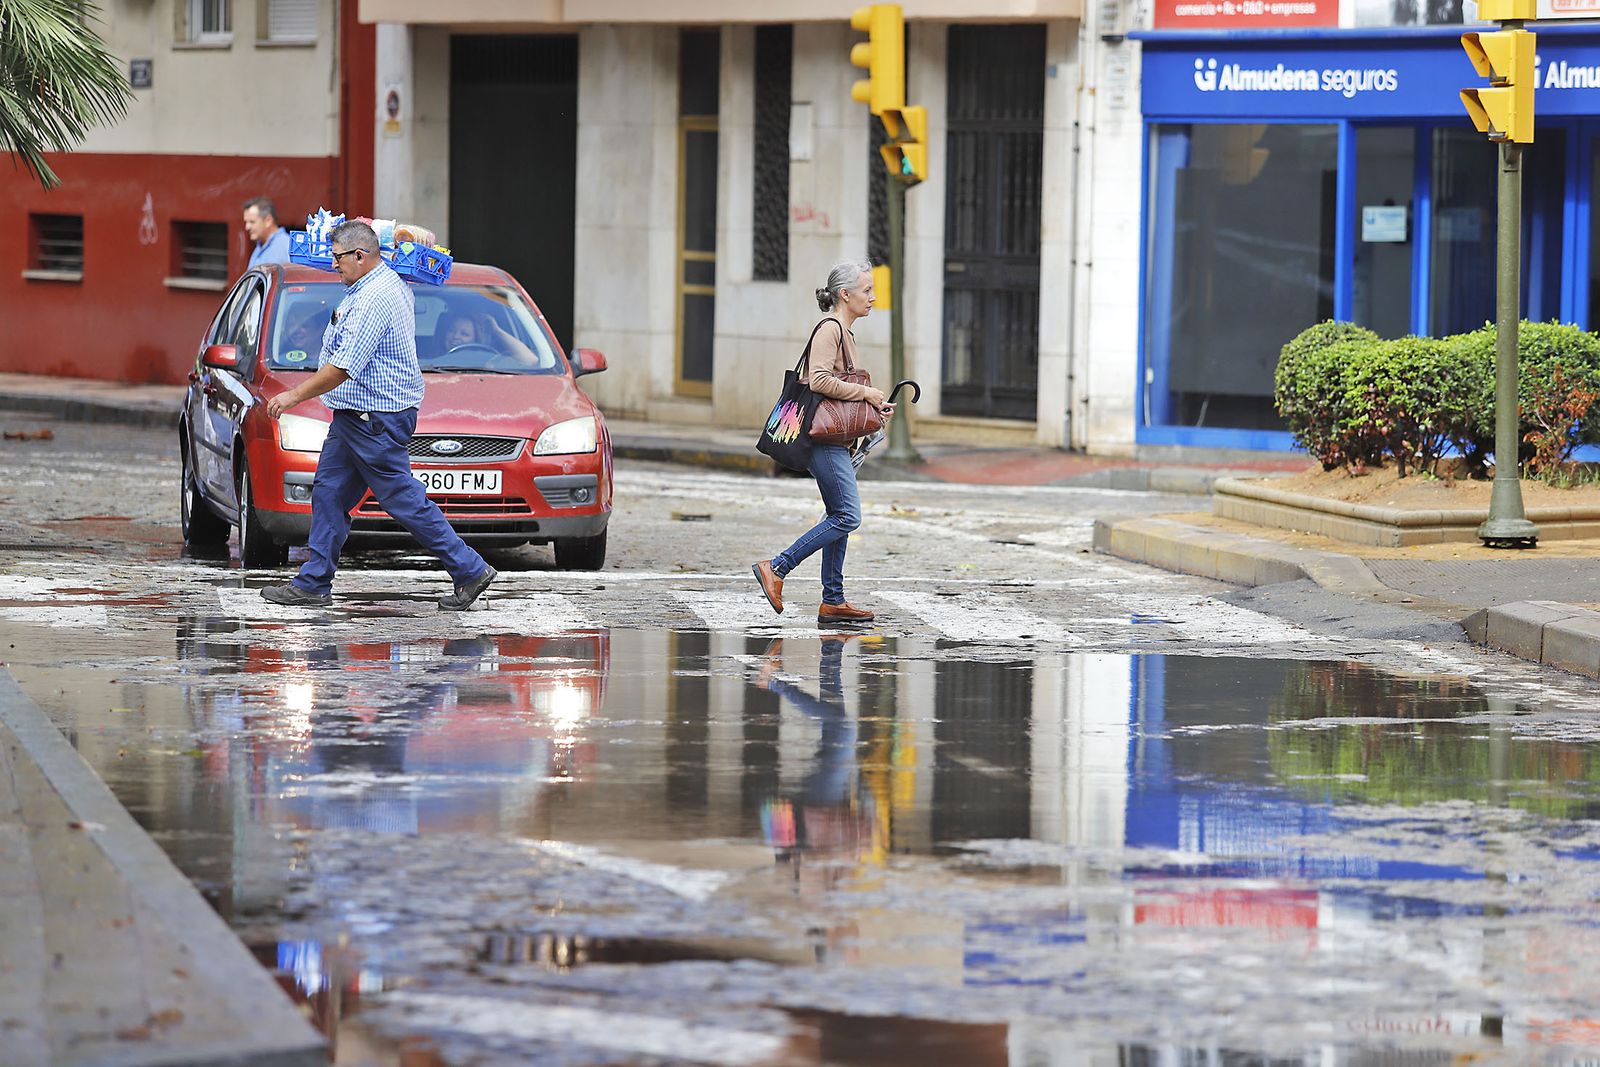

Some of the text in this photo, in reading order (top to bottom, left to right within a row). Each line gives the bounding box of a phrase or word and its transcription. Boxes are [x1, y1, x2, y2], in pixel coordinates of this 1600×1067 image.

[1270, 2, 1316, 16] empresas
[1218, 63, 1398, 98] Almudena seguros
[1543, 60, 1600, 89] Almu
[410, 472, 497, 491] 360 FMJ
